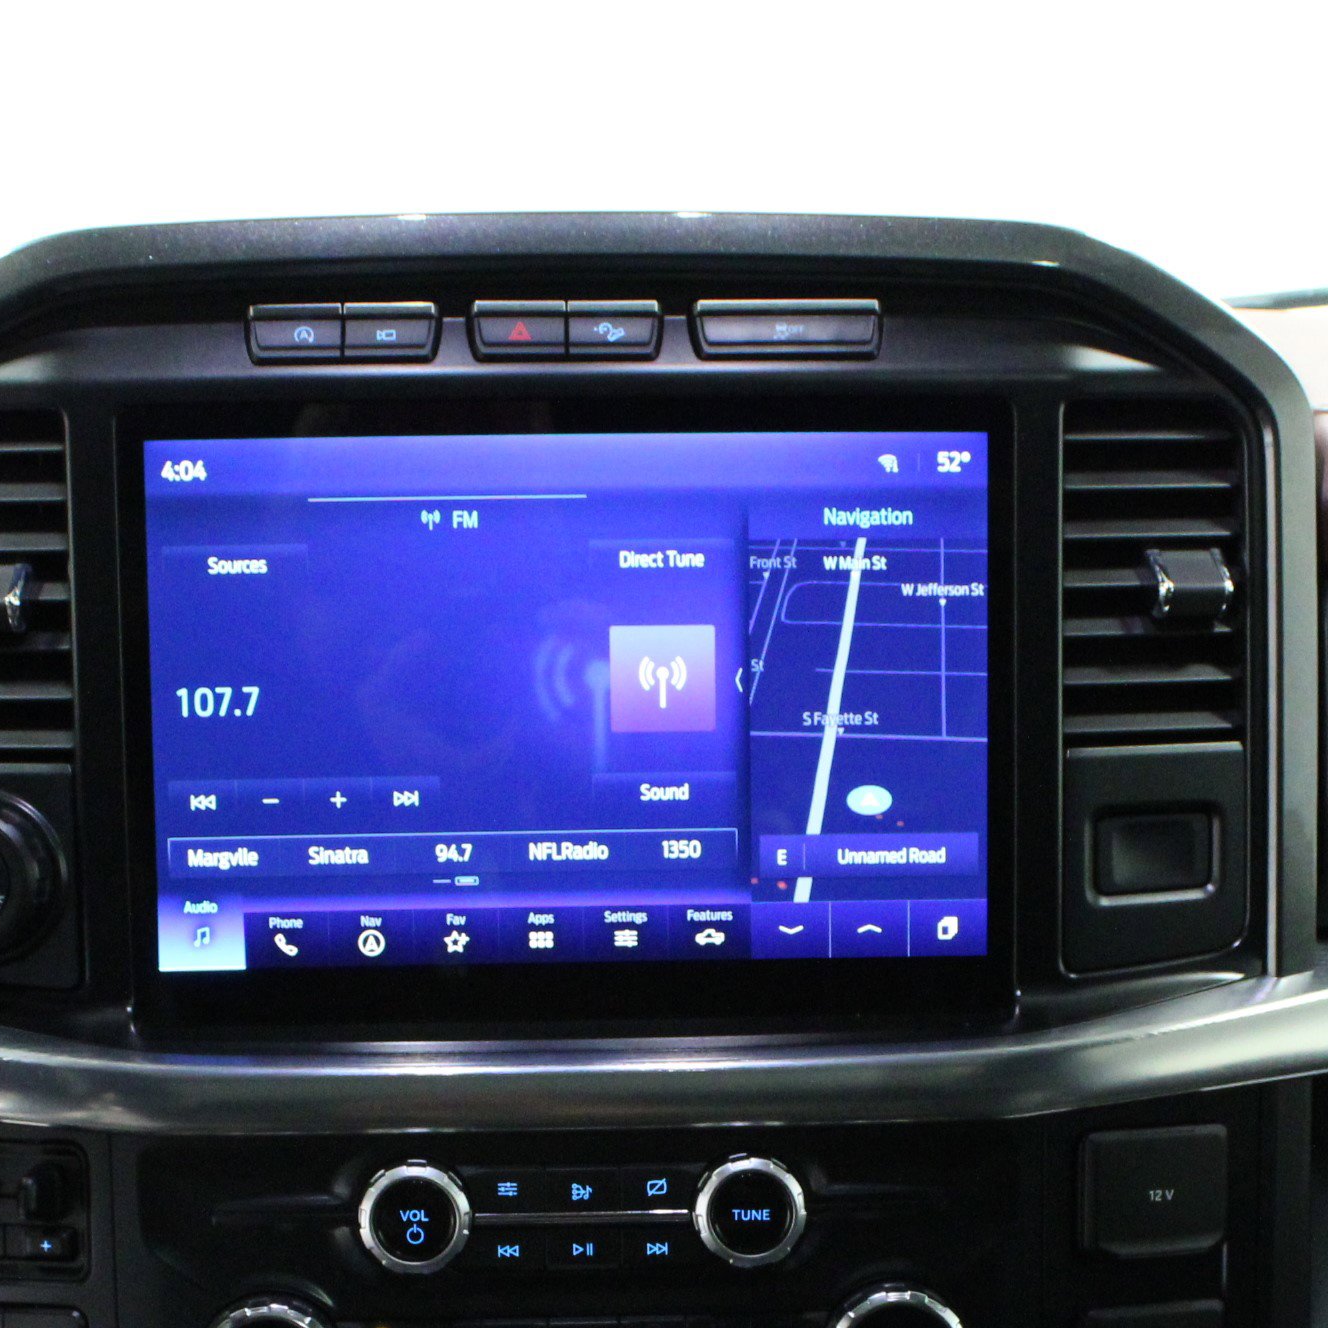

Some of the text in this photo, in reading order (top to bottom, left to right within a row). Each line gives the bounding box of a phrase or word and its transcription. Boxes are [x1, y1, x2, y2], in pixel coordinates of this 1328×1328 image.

[161, 460, 207, 482] 4:04
[452, 510, 479, 529] FM
[823, 507, 913, 529] Navigation
[207, 557, 268, 575] Sources
[619, 549, 705, 568] Direct Tune
[749, 556, 797, 569] Front St
[823, 556, 887, 570] W Main St
[901, 582, 984, 597] W Jefferson St
[176, 686, 260, 718] 107.7
[802, 711, 879, 728] S Fayette St
[639, 782, 690, 802] Sound
[307, 846, 370, 866] Sinatra
[434, 844, 473, 863] 94.7
[661, 839, 702, 859] 1350
[836, 846, 947, 866] Unnamed Road
[776, 849, 788, 866] E
[183, 901, 219, 915] Audio
[686, 908, 734, 923] Features
[268, 917, 304, 930] Phone
[360, 915, 382, 928] Nav
[445, 913, 467, 927] Fav
[527, 911, 555, 926] Apps
[603, 910, 648, 926] Settings
[1149, 1189, 1175, 1202] 12 V
[400, 1210, 430, 1222] VOL
[732, 1209, 771, 1222] TUNE
